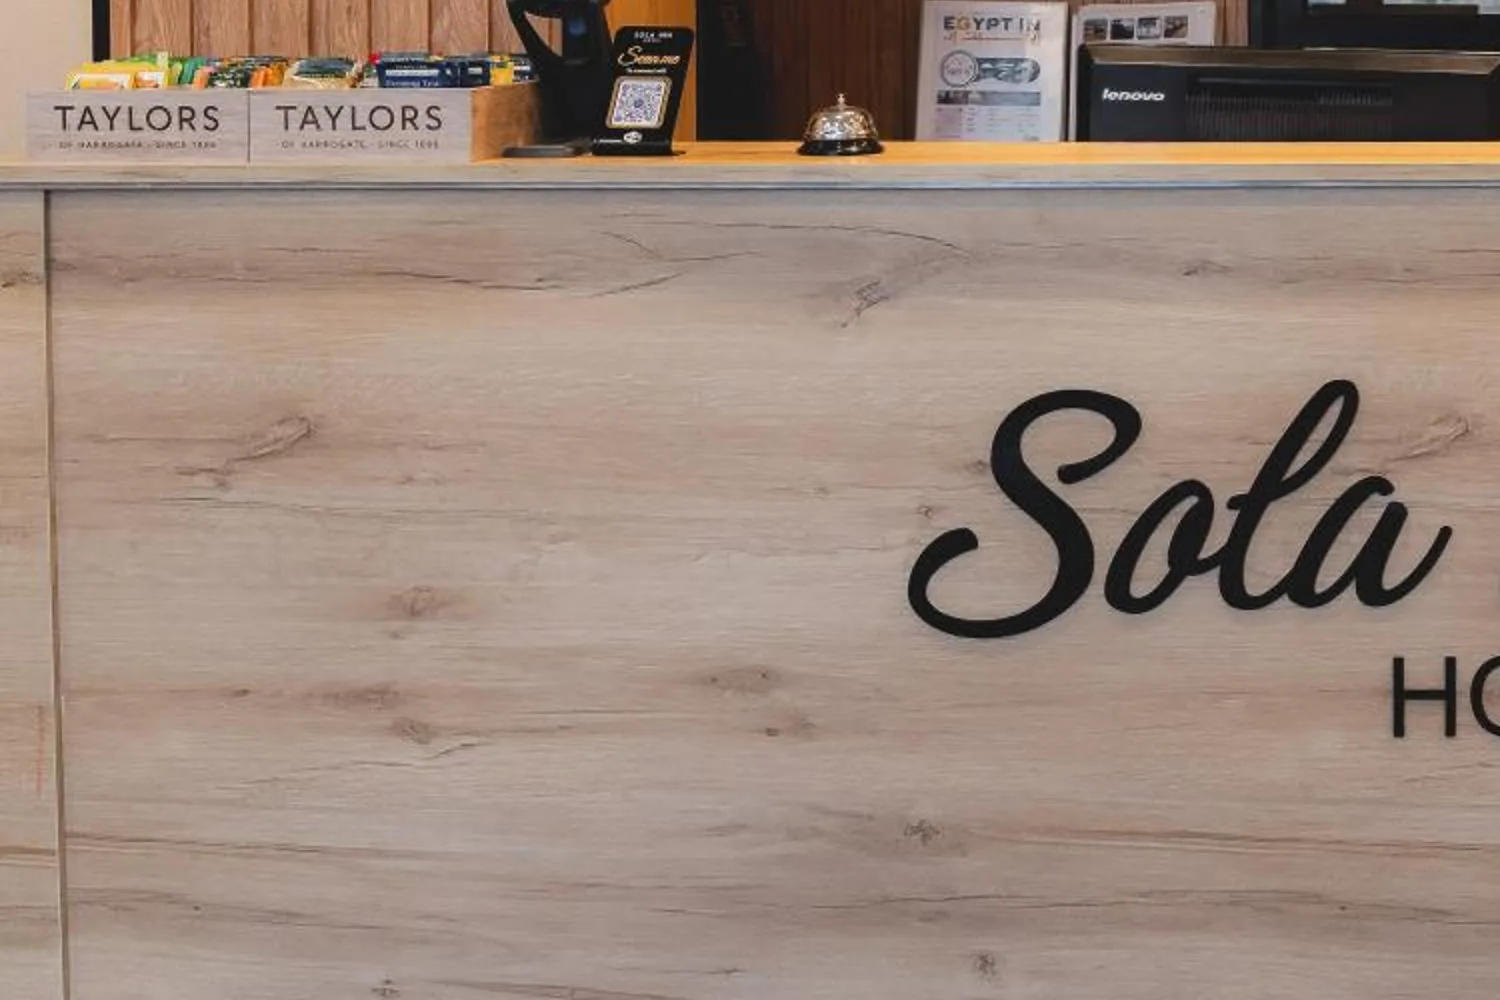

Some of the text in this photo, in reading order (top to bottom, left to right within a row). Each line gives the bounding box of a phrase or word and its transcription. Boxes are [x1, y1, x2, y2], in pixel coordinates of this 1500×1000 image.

[943, 16, 1013, 31] EGYPT
[1102, 87, 1166, 101] lenovo
[53, 105, 220, 132] TAYLORS
[275, 105, 443, 132] TAYLORS
[905, 378, 1453, 639] Sola
